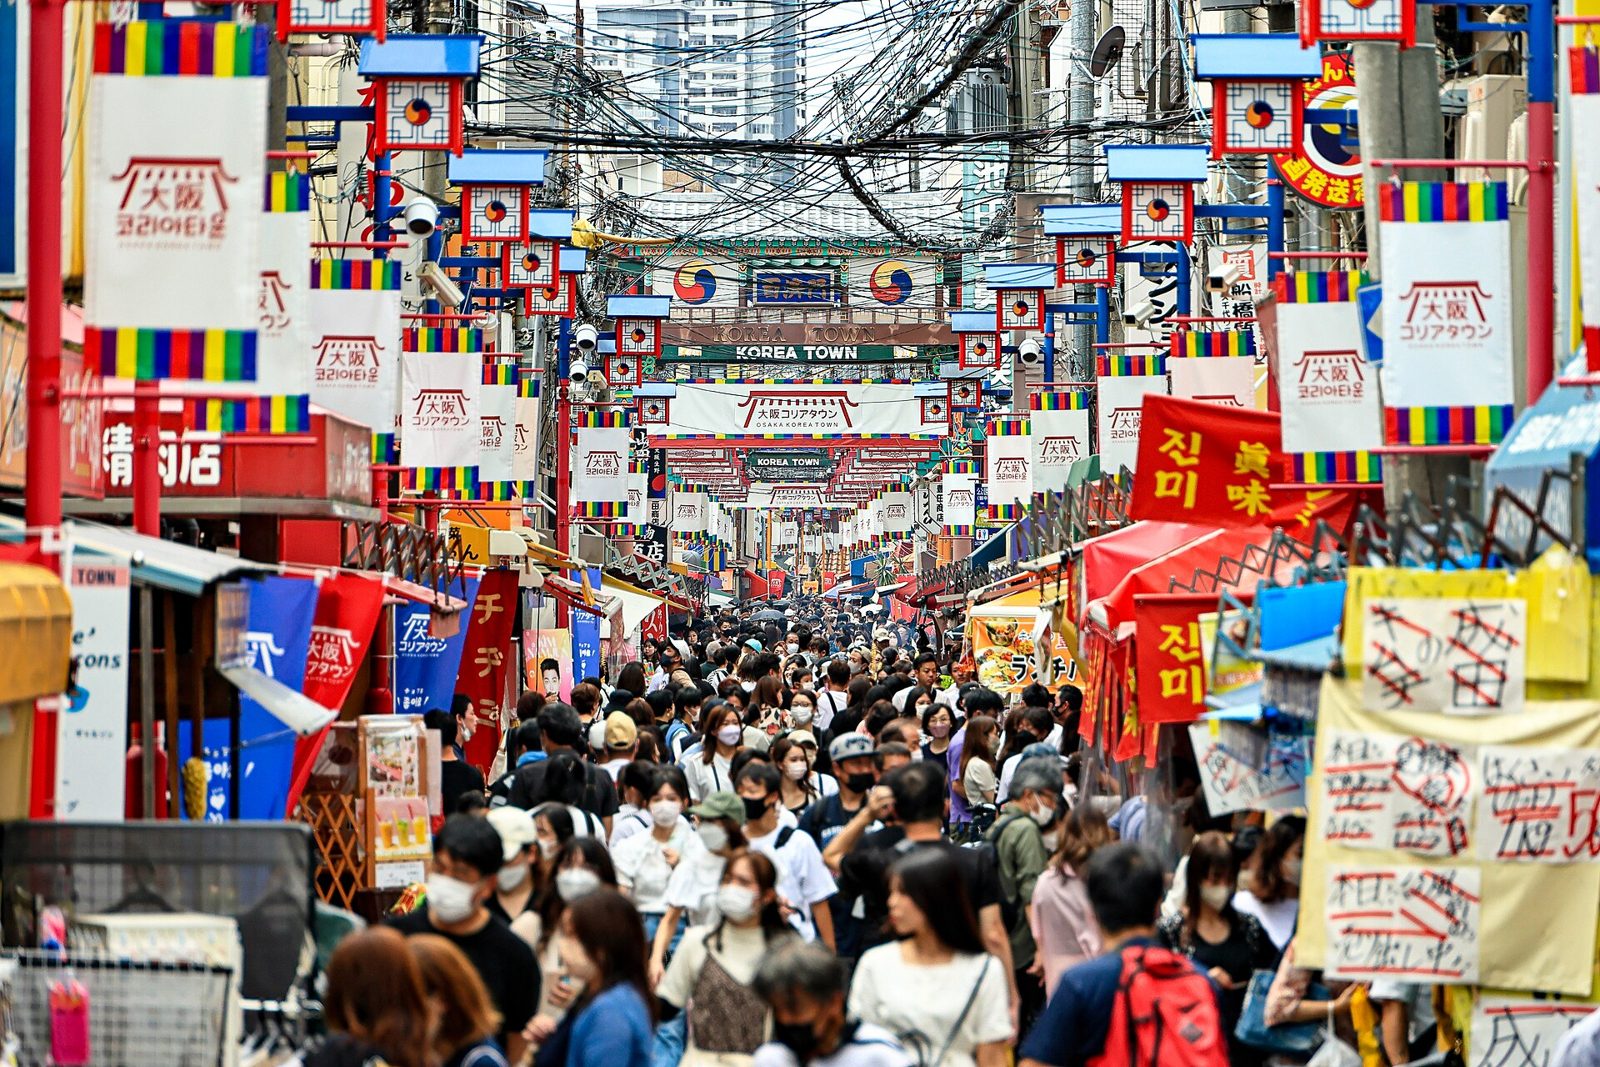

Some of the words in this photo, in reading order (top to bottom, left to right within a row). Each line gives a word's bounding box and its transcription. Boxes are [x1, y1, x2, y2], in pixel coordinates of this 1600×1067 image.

[141, 182, 205, 211] 大阪
[117, 212, 226, 239] 코리아타운
[1422, 300, 1468, 321] 大阪
[713, 327, 787, 342] KOREA
[813, 327, 876, 342] TOWN
[1400, 324, 1493, 340] コリアタウン
[329, 350, 365, 367] 大阪
[737, 346, 798, 360] KOREA
[803, 346, 857, 360] TOWN
[315, 367, 378, 382] 코리아타운
[1312, 365, 1348, 382] 大阪
[1297, 381, 1363, 398] 코리아타운
[426, 401, 456, 414] 大阪
[758, 409, 838, 419] 大阪コリアタウン
[412, 416, 470, 426] コリアタウン
[1049, 444, 1070, 455] 大阪
[592, 458, 612, 467] 大阪
[757, 458, 789, 466] KOREA
[792, 458, 820, 466] TOWN
[1002, 464, 1020, 473] 大阪
[1155, 428, 1202, 509] 진미
[585, 467, 620, 476] 코리아타운
[652, 500, 660, 526] 田商店
[77, 569, 117, 585] TOWN
[307, 641, 342, 662] 大阪
[398, 641, 448, 653] コリアタウン
[474, 593, 504, 728] チヂミ
[1158, 621, 1204, 705] 진미
